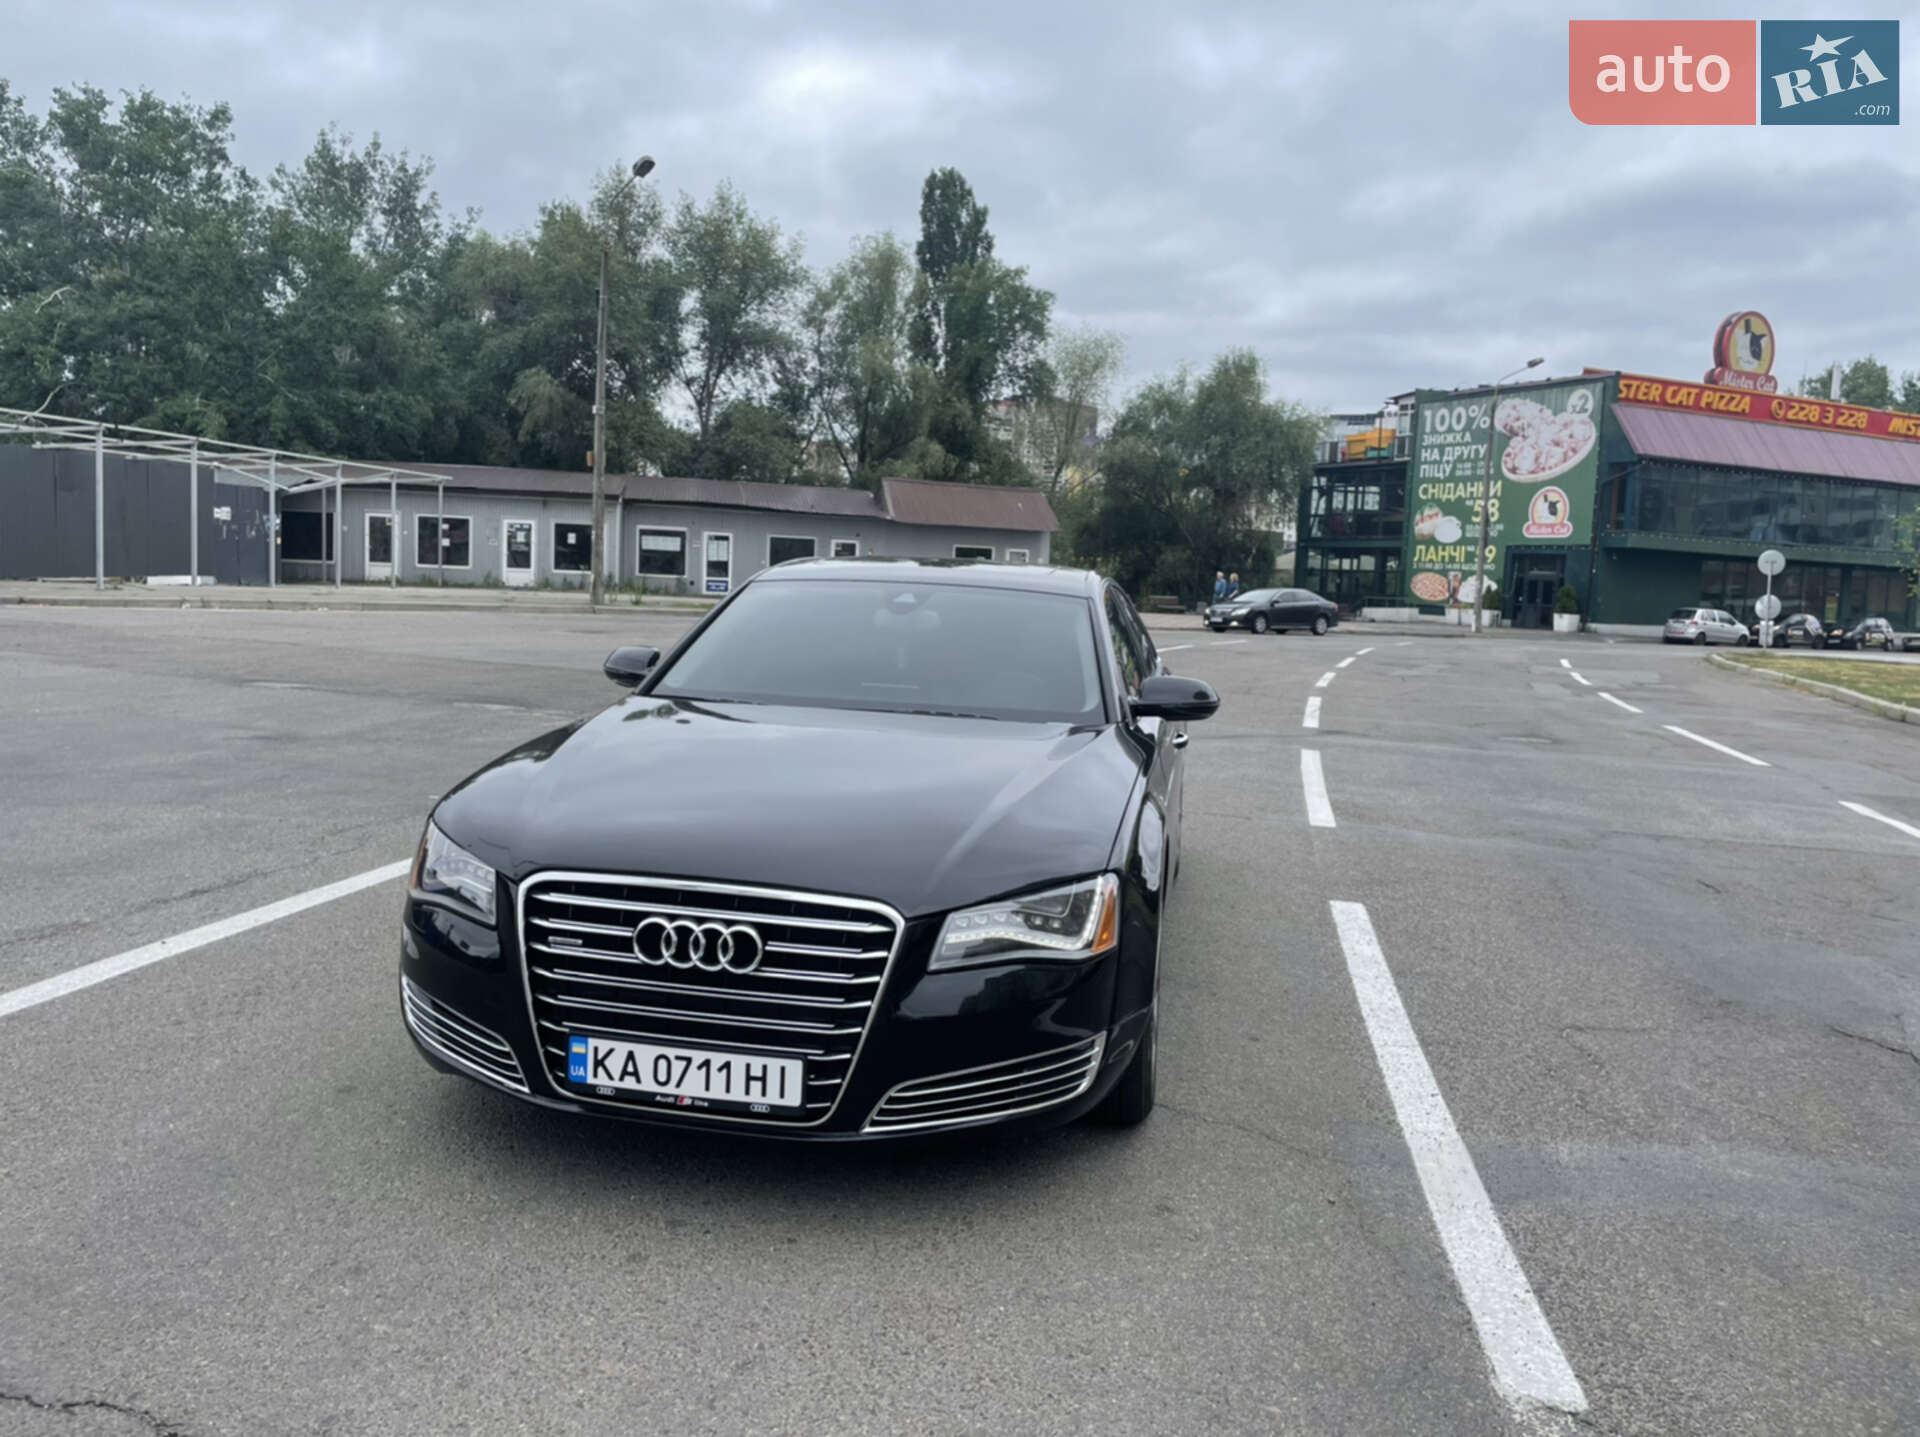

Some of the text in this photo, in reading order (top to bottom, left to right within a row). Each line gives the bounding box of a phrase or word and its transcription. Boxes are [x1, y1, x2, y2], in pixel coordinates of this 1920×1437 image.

[1719, 371, 1776, 392] Mister Cat
[1423, 403, 1490, 433] 100%
[1665, 386, 1699, 406] CAT
[1700, 390, 1750, 413] PIZZA
[1786, 402, 1820, 422] 228
[1822, 407, 1834, 424] 3
[1836, 409, 1868, 429] 228
[1421, 443, 1487, 464] НА ДРУГУ
[1420, 463, 1453, 479] ПІЦУ
[1413, 545, 1465, 563] ЛАНЧІ
[570, 1065, 585, 1077] UA
[592, 1046, 786, 1100] KA 0711 HI
